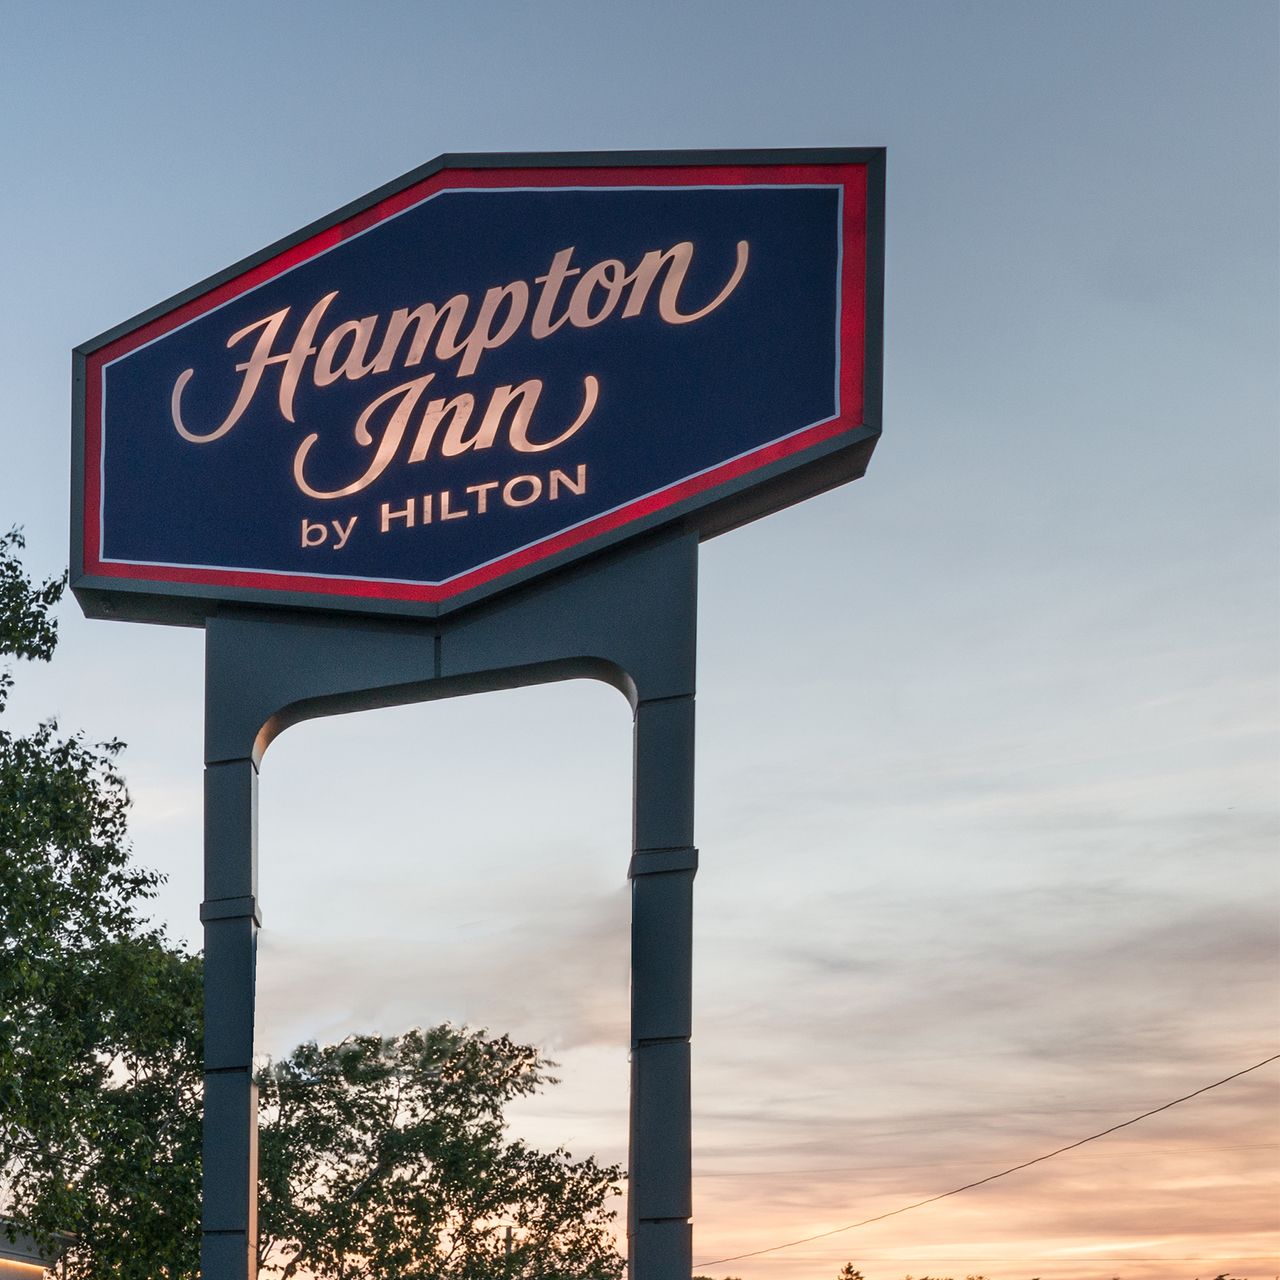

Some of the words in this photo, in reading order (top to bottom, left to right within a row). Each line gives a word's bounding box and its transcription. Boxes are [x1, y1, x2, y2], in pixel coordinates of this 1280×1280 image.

[172, 240, 749, 444] Hampton
[293, 373, 599, 500] Inn
[301, 517, 358, 549] by
[381, 464, 588, 533] HILTON
